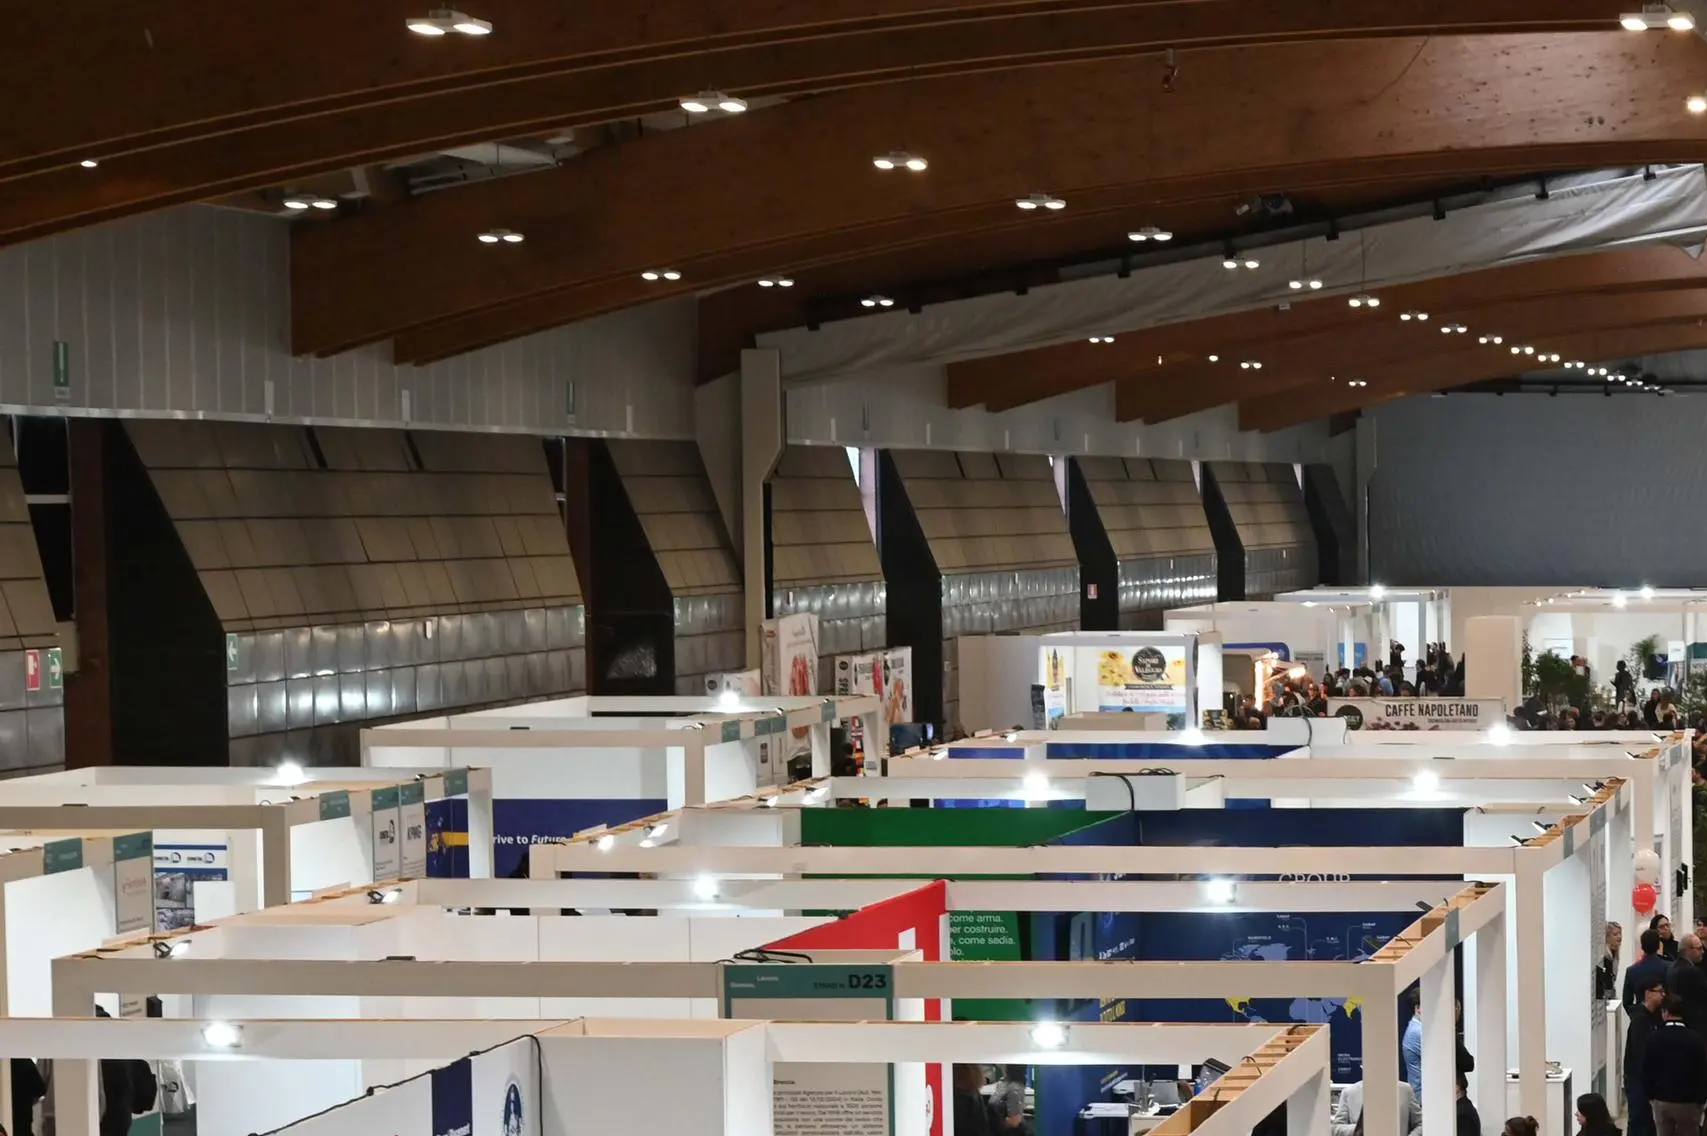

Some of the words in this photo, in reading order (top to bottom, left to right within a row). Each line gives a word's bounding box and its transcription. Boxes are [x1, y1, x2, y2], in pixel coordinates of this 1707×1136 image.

[1418, 704, 1478, 717] NAPOLETANO
[516, 834, 529, 844] to
[848, 974, 886, 989] D23
